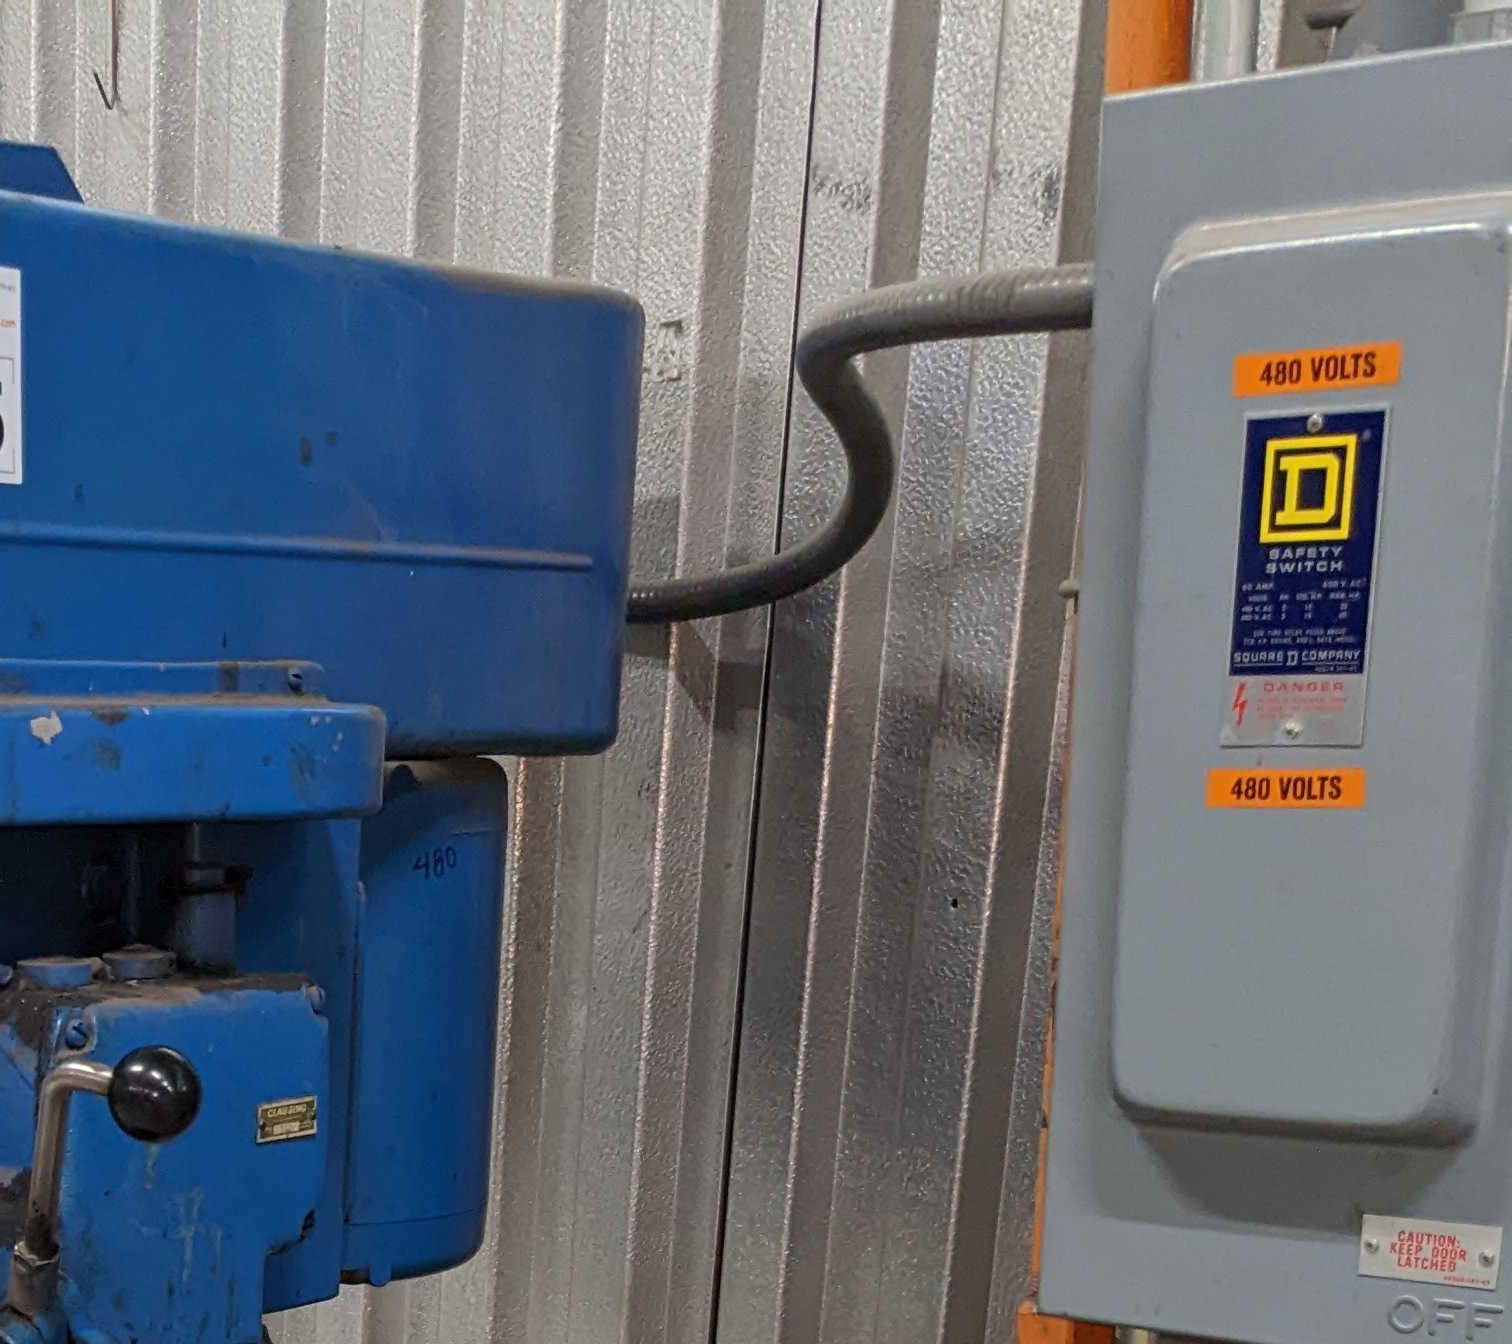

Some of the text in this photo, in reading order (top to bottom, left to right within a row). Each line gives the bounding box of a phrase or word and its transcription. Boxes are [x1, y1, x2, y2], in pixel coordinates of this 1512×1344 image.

[1260, 351, 1377, 386] 480 VOLTS
[1269, 546, 1343, 560] SAFETY
[1265, 560, 1344, 574] SWITCH
[1233, 650, 1360, 666] SQUARE D COMPANY
[1263, 681, 1344, 692] DANGER
[1231, 775, 1342, 801] 480 VOLTS
[412, 845, 457, 880] 480
[1397, 1230, 1461, 1249] CAUTION:
[1390, 1242, 1467, 1262] KEEP DOOR
[1397, 1255, 1456, 1272] LATCHED
[1388, 1294, 1504, 1341] OFF
